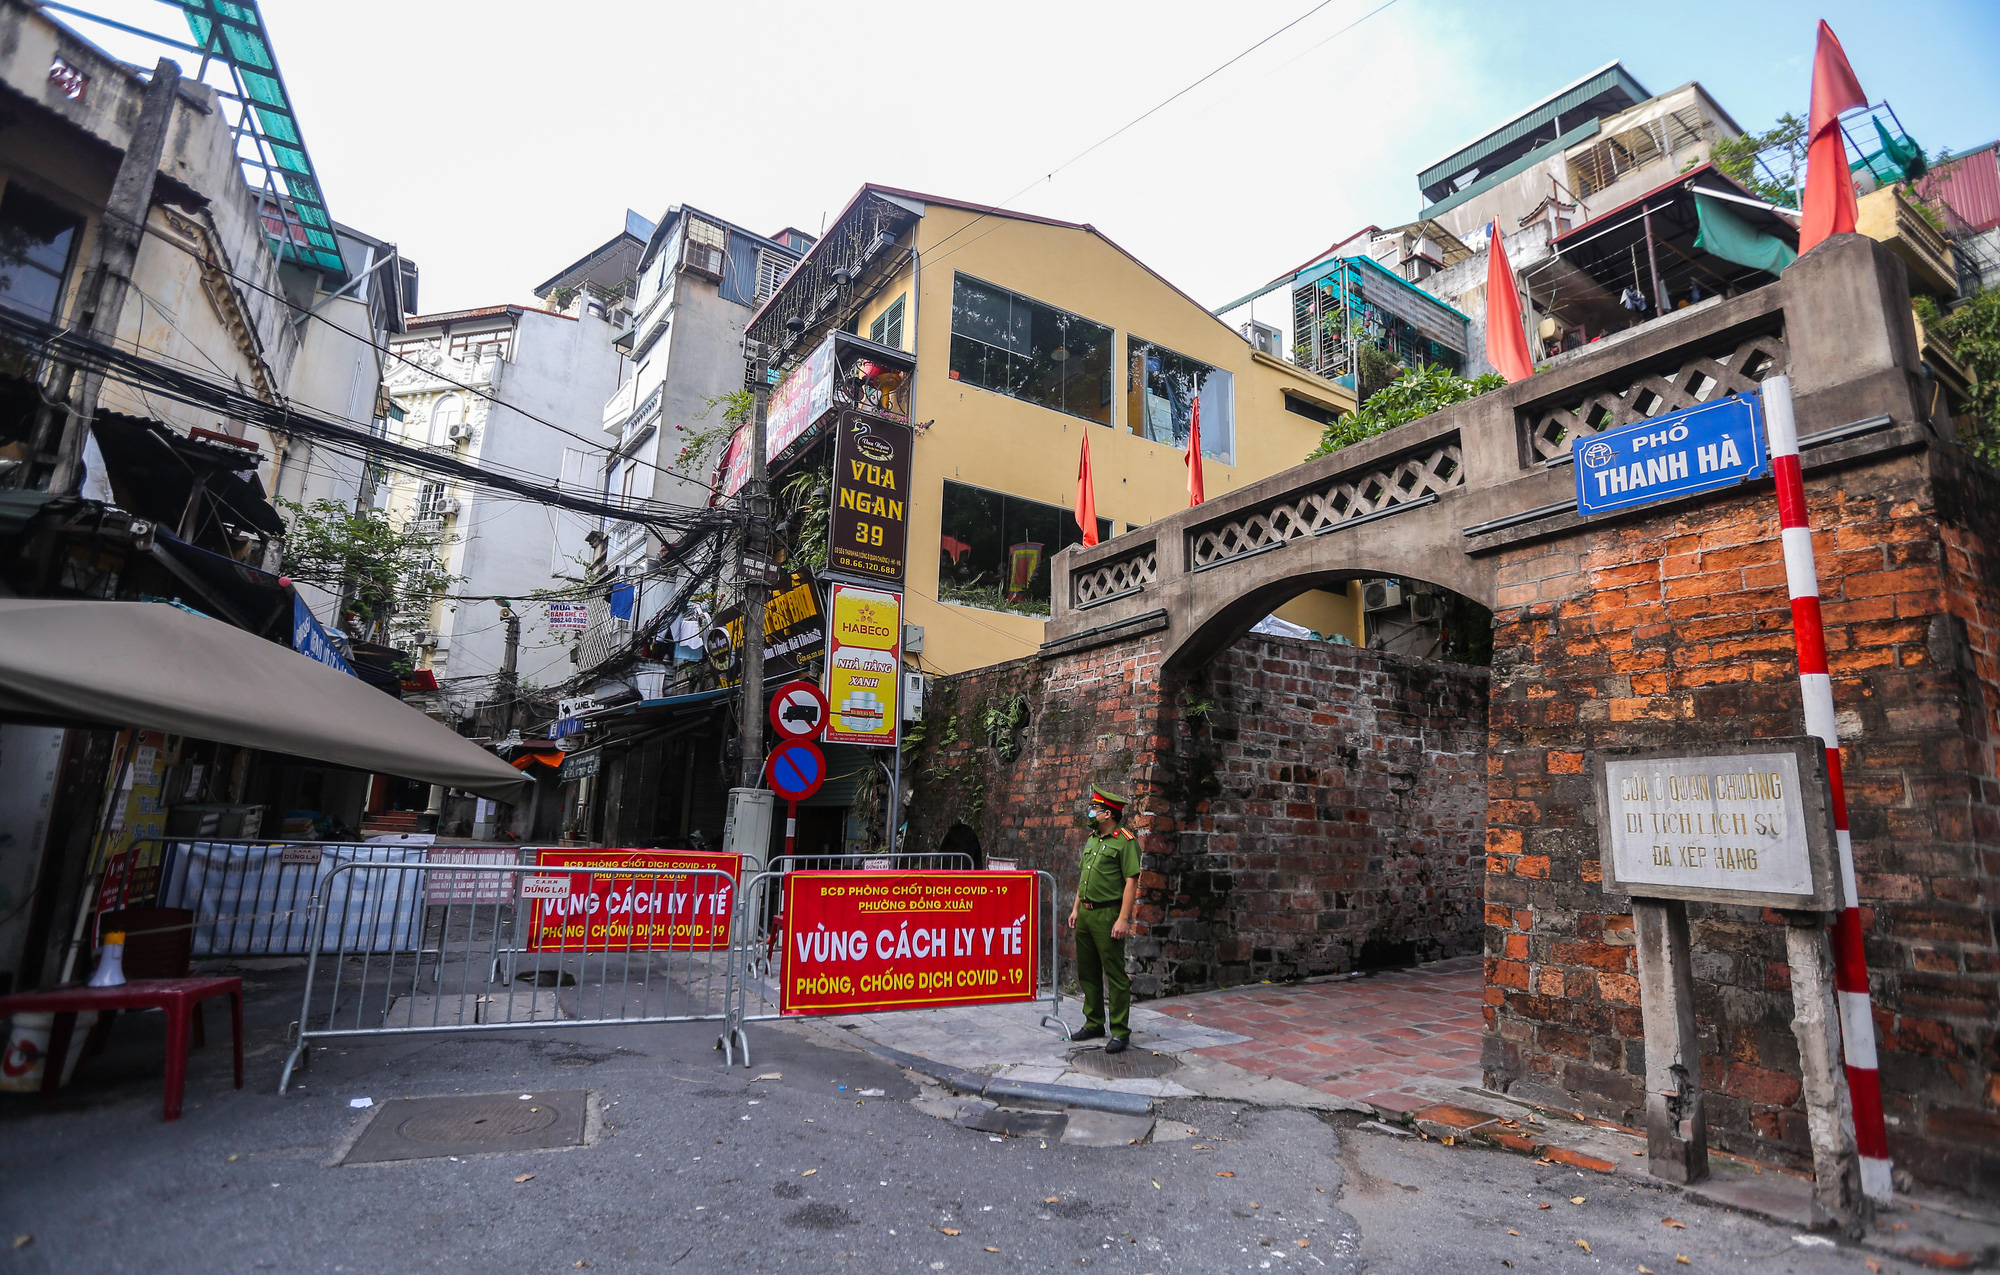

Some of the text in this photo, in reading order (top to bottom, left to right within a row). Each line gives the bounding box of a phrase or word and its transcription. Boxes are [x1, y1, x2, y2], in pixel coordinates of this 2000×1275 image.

[1632, 417, 1689, 453] PHỐ
[850, 459, 896, 490] VUA
[1594, 433, 1742, 497] THANH HÀ
[839, 487, 904, 521] NGAN
[856, 522, 883, 546] 39
[840, 557, 896, 575] 08.66.120.688
[842, 622, 890, 637] HABECO
[837, 657, 892, 673] NHÀ HÀNG
[848, 676, 879, 688] XANH
[1653, 771, 1664, 801] Ô
[1668, 775, 1710, 802] QUAN
[1626, 813, 1643, 834] DI
[1697, 813, 1747, 838] LỊCH
[586, 859, 619, 868] PHÒNG
[621, 857, 646, 868] CHỐT
[671, 861, 699, 869] COVID
[1653, 838, 1758, 873] ĐÃ XẾP HẠNG
[524, 884, 550, 893] DỪNG
[605, 886, 661, 915] CÁCH
[667, 893, 688, 914] LY
[692, 893, 705, 914] Y
[708, 885, 731, 915] TẾ
[820, 887, 844, 897] BCĐ
[848, 885, 889, 896] PHÒNG
[892, 882, 924, 895] CHỐT
[926, 886, 951, 897] DỊCH
[954, 886, 988, 895] COVID
[996, 886, 1008, 895] 19
[858, 896, 973, 911] PHƯỜNG ĐỒNG XUÂN
[591, 919, 634, 937] CHỐNG
[636, 924, 665, 939] DỊCH
[668, 924, 704, 937] COVID
[712, 925, 724, 937] 19
[796, 914, 1027, 964] VÙNG CÁCH LY Y TẾ
[796, 973, 856, 996] PHÒNG,
[859, 967, 915, 993] CHỐNG
[918, 971, 953, 993] DỊCH
[956, 970, 999, 987] COVID
[1008, 968, 1023, 985] 19
